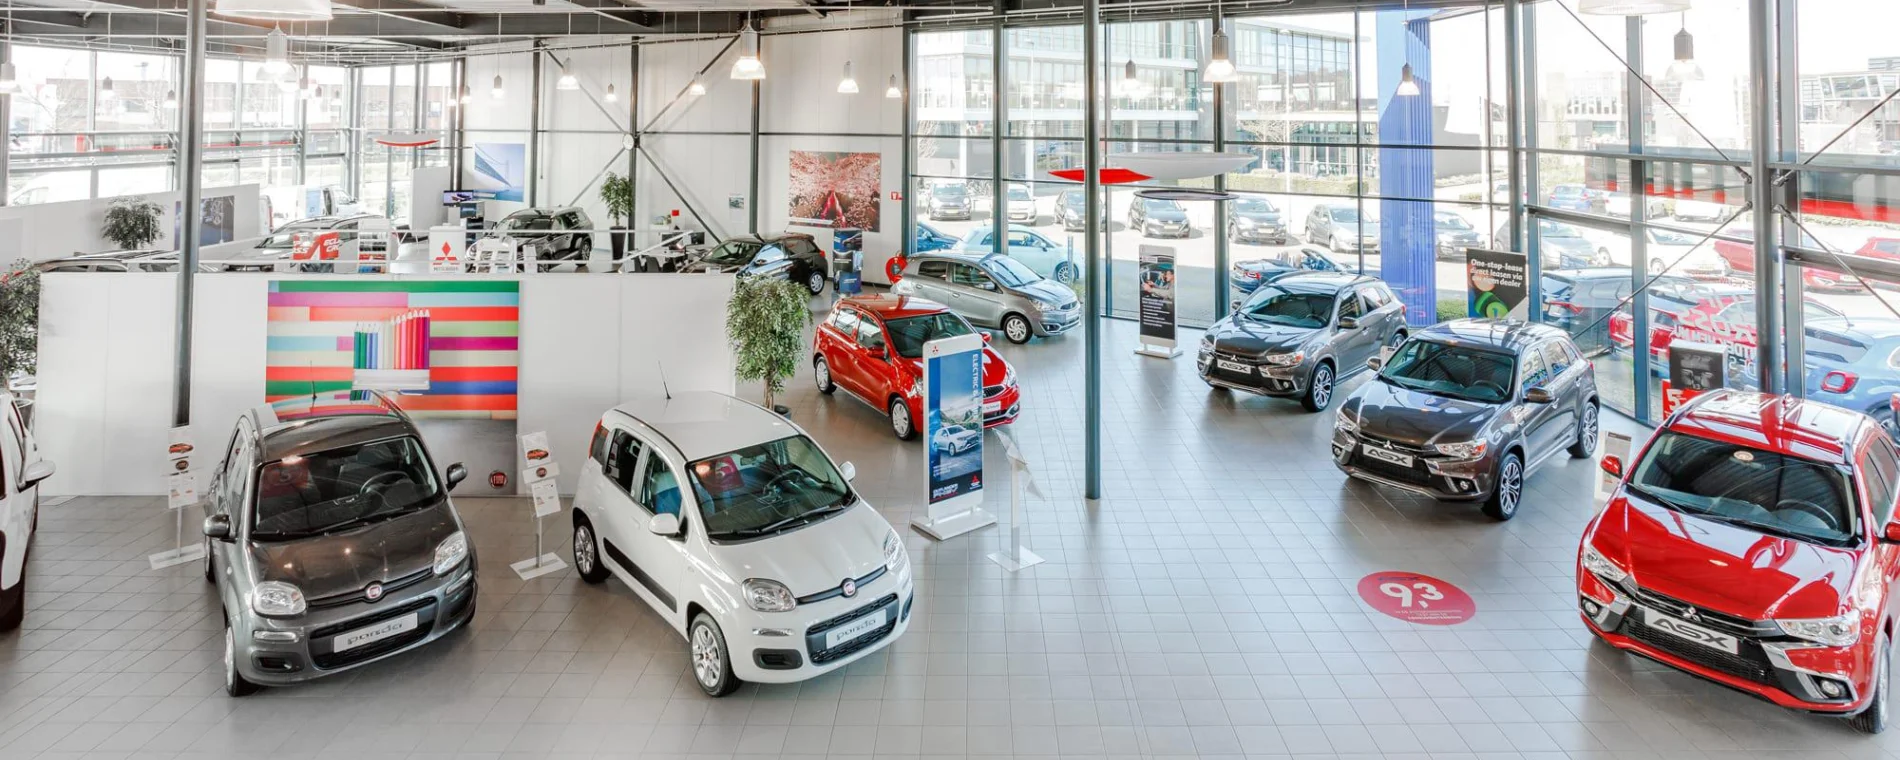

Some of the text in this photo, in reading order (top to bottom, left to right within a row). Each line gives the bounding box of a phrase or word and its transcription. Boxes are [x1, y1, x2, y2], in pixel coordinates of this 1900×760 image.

[1471, 258, 1523, 272] One-stop-lease
[1470, 266, 1523, 281] direct leasen via
[1500, 278, 1521, 288] dealer
[1221, 361, 1247, 372] ASX
[1367, 448, 1408, 465] ASX
[347, 621, 403, 645] panda
[836, 618, 876, 641] panda
[1652, 618, 1729, 649] ASX
